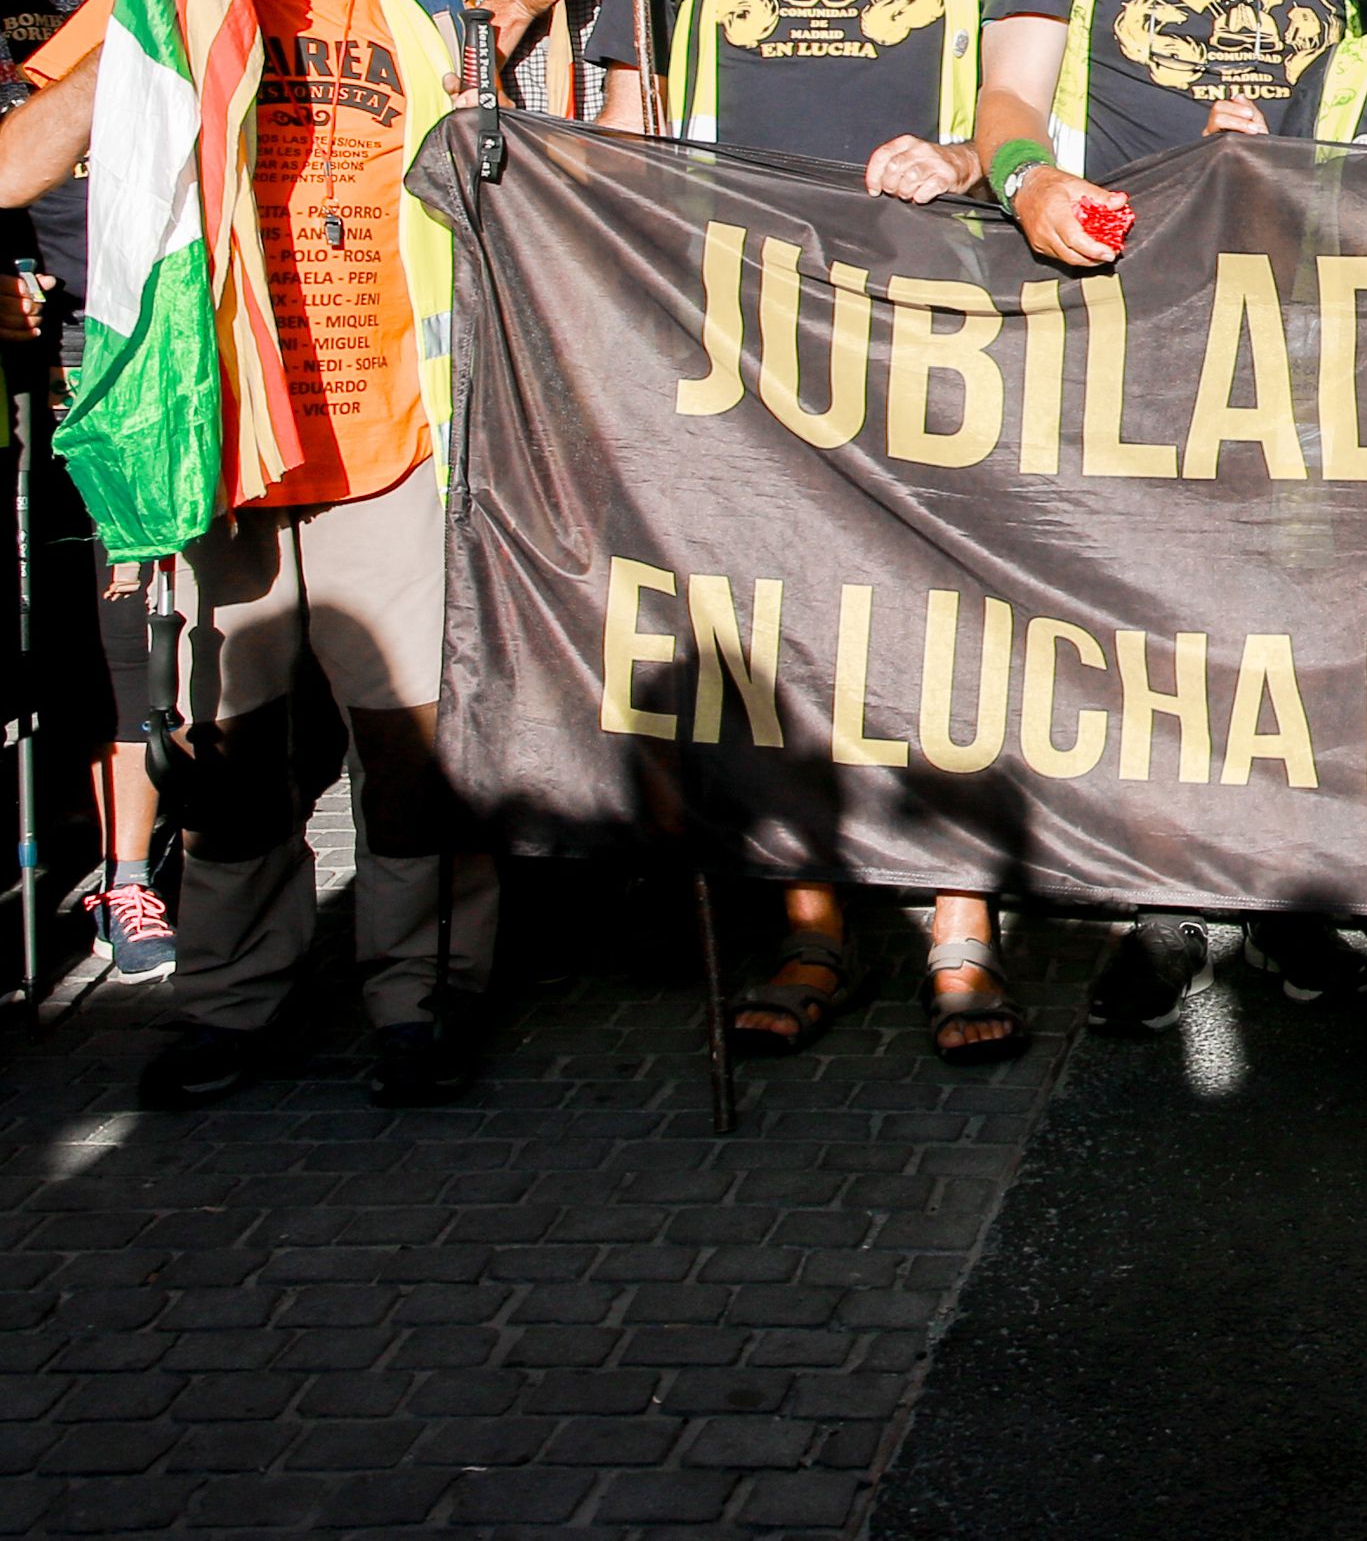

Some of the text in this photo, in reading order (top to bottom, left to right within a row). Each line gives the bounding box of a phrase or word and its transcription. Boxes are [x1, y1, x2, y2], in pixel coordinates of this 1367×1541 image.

[779, 7, 860, 18] COMUNIDAD
[809, 19, 829, 29] DE
[790, 29, 845, 40] MADRID
[760, 41, 879, 60] EN LUCHA
[1192, 85, 1226, 101] EN
[281, 173, 357, 184] PENTSOAK
[296, 227, 373, 241] ANNIA
[343, 250, 382, 263] ROSA
[348, 271, 378, 285] PEPI
[354, 293, 380, 306] JENI
[325, 314, 379, 329] MIQUEL
[314, 336, 370, 351] MIGUEL
[355, 356, 388, 372] SOFIA
[302, 401, 361, 418] VICTOR
[601, 555, 786, 749] EN
[831, 583, 1319, 789] LUCHA
